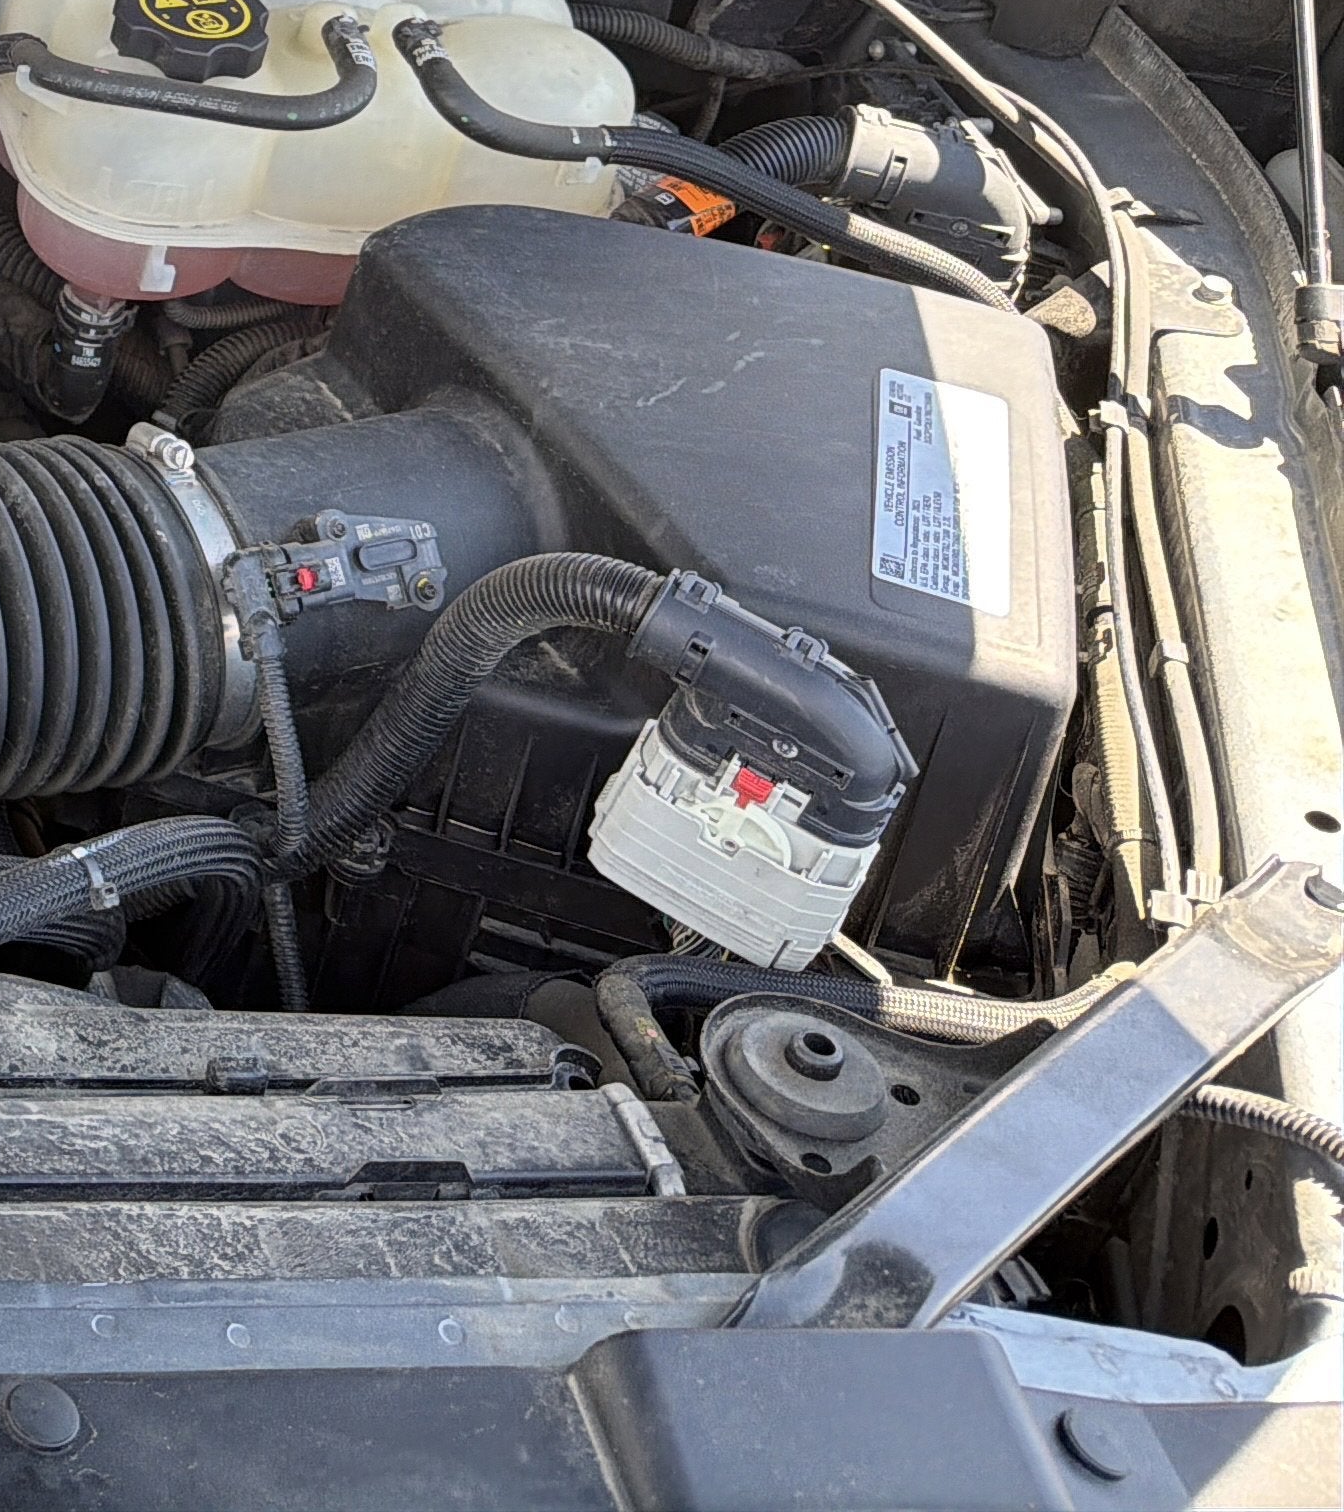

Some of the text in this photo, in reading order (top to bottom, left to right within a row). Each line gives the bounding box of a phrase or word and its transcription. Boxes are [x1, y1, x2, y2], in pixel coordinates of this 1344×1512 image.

[884, 444, 896, 513] VEHICLE EMISSION
[894, 440, 907, 527] CONTROL INFORMATION
